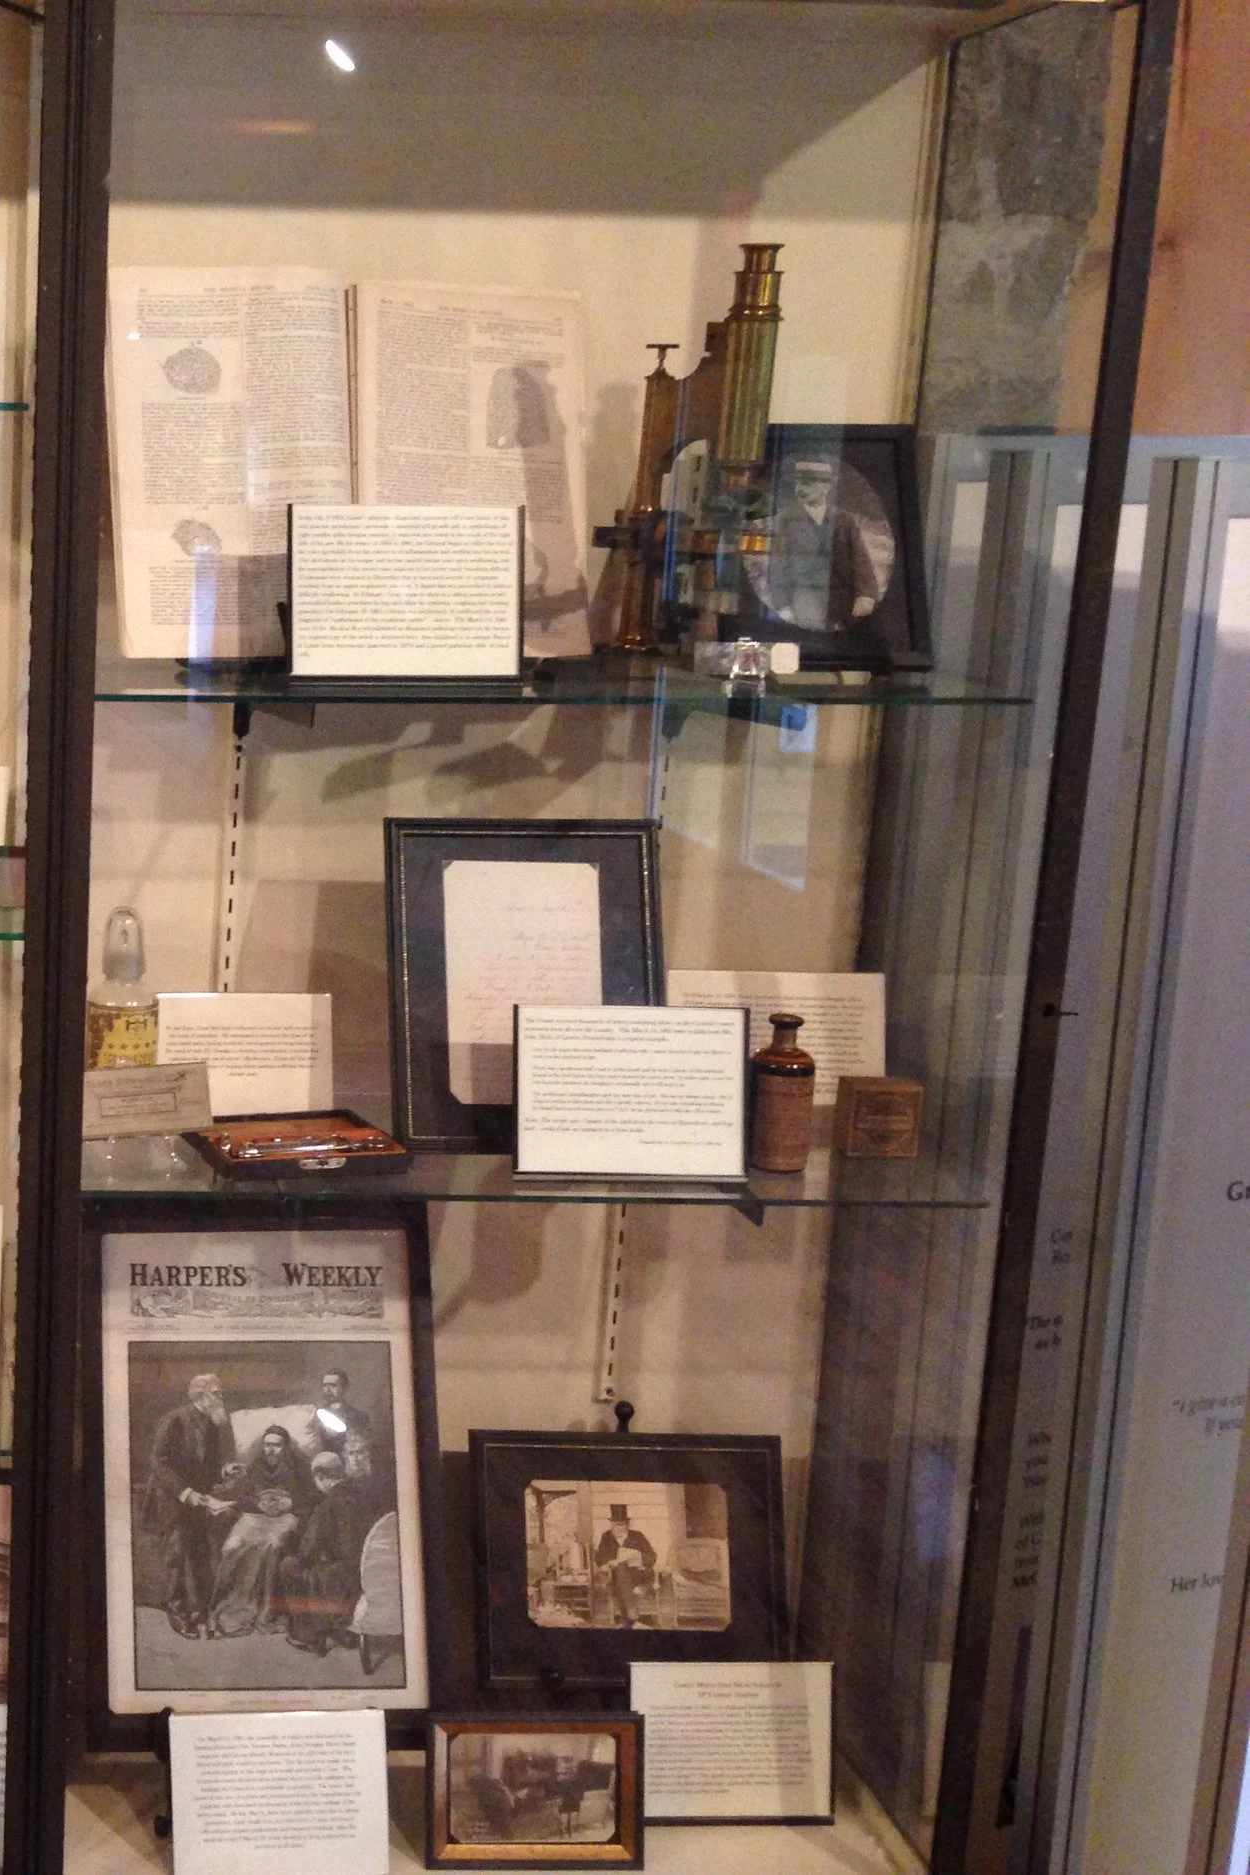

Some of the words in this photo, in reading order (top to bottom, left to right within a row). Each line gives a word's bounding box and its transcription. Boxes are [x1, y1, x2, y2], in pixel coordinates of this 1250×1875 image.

[129, 1263, 248, 1287] HARPER'S
[282, 1262, 384, 1287] WEEKLY
[1171, 1576, 1197, 1592] Her
